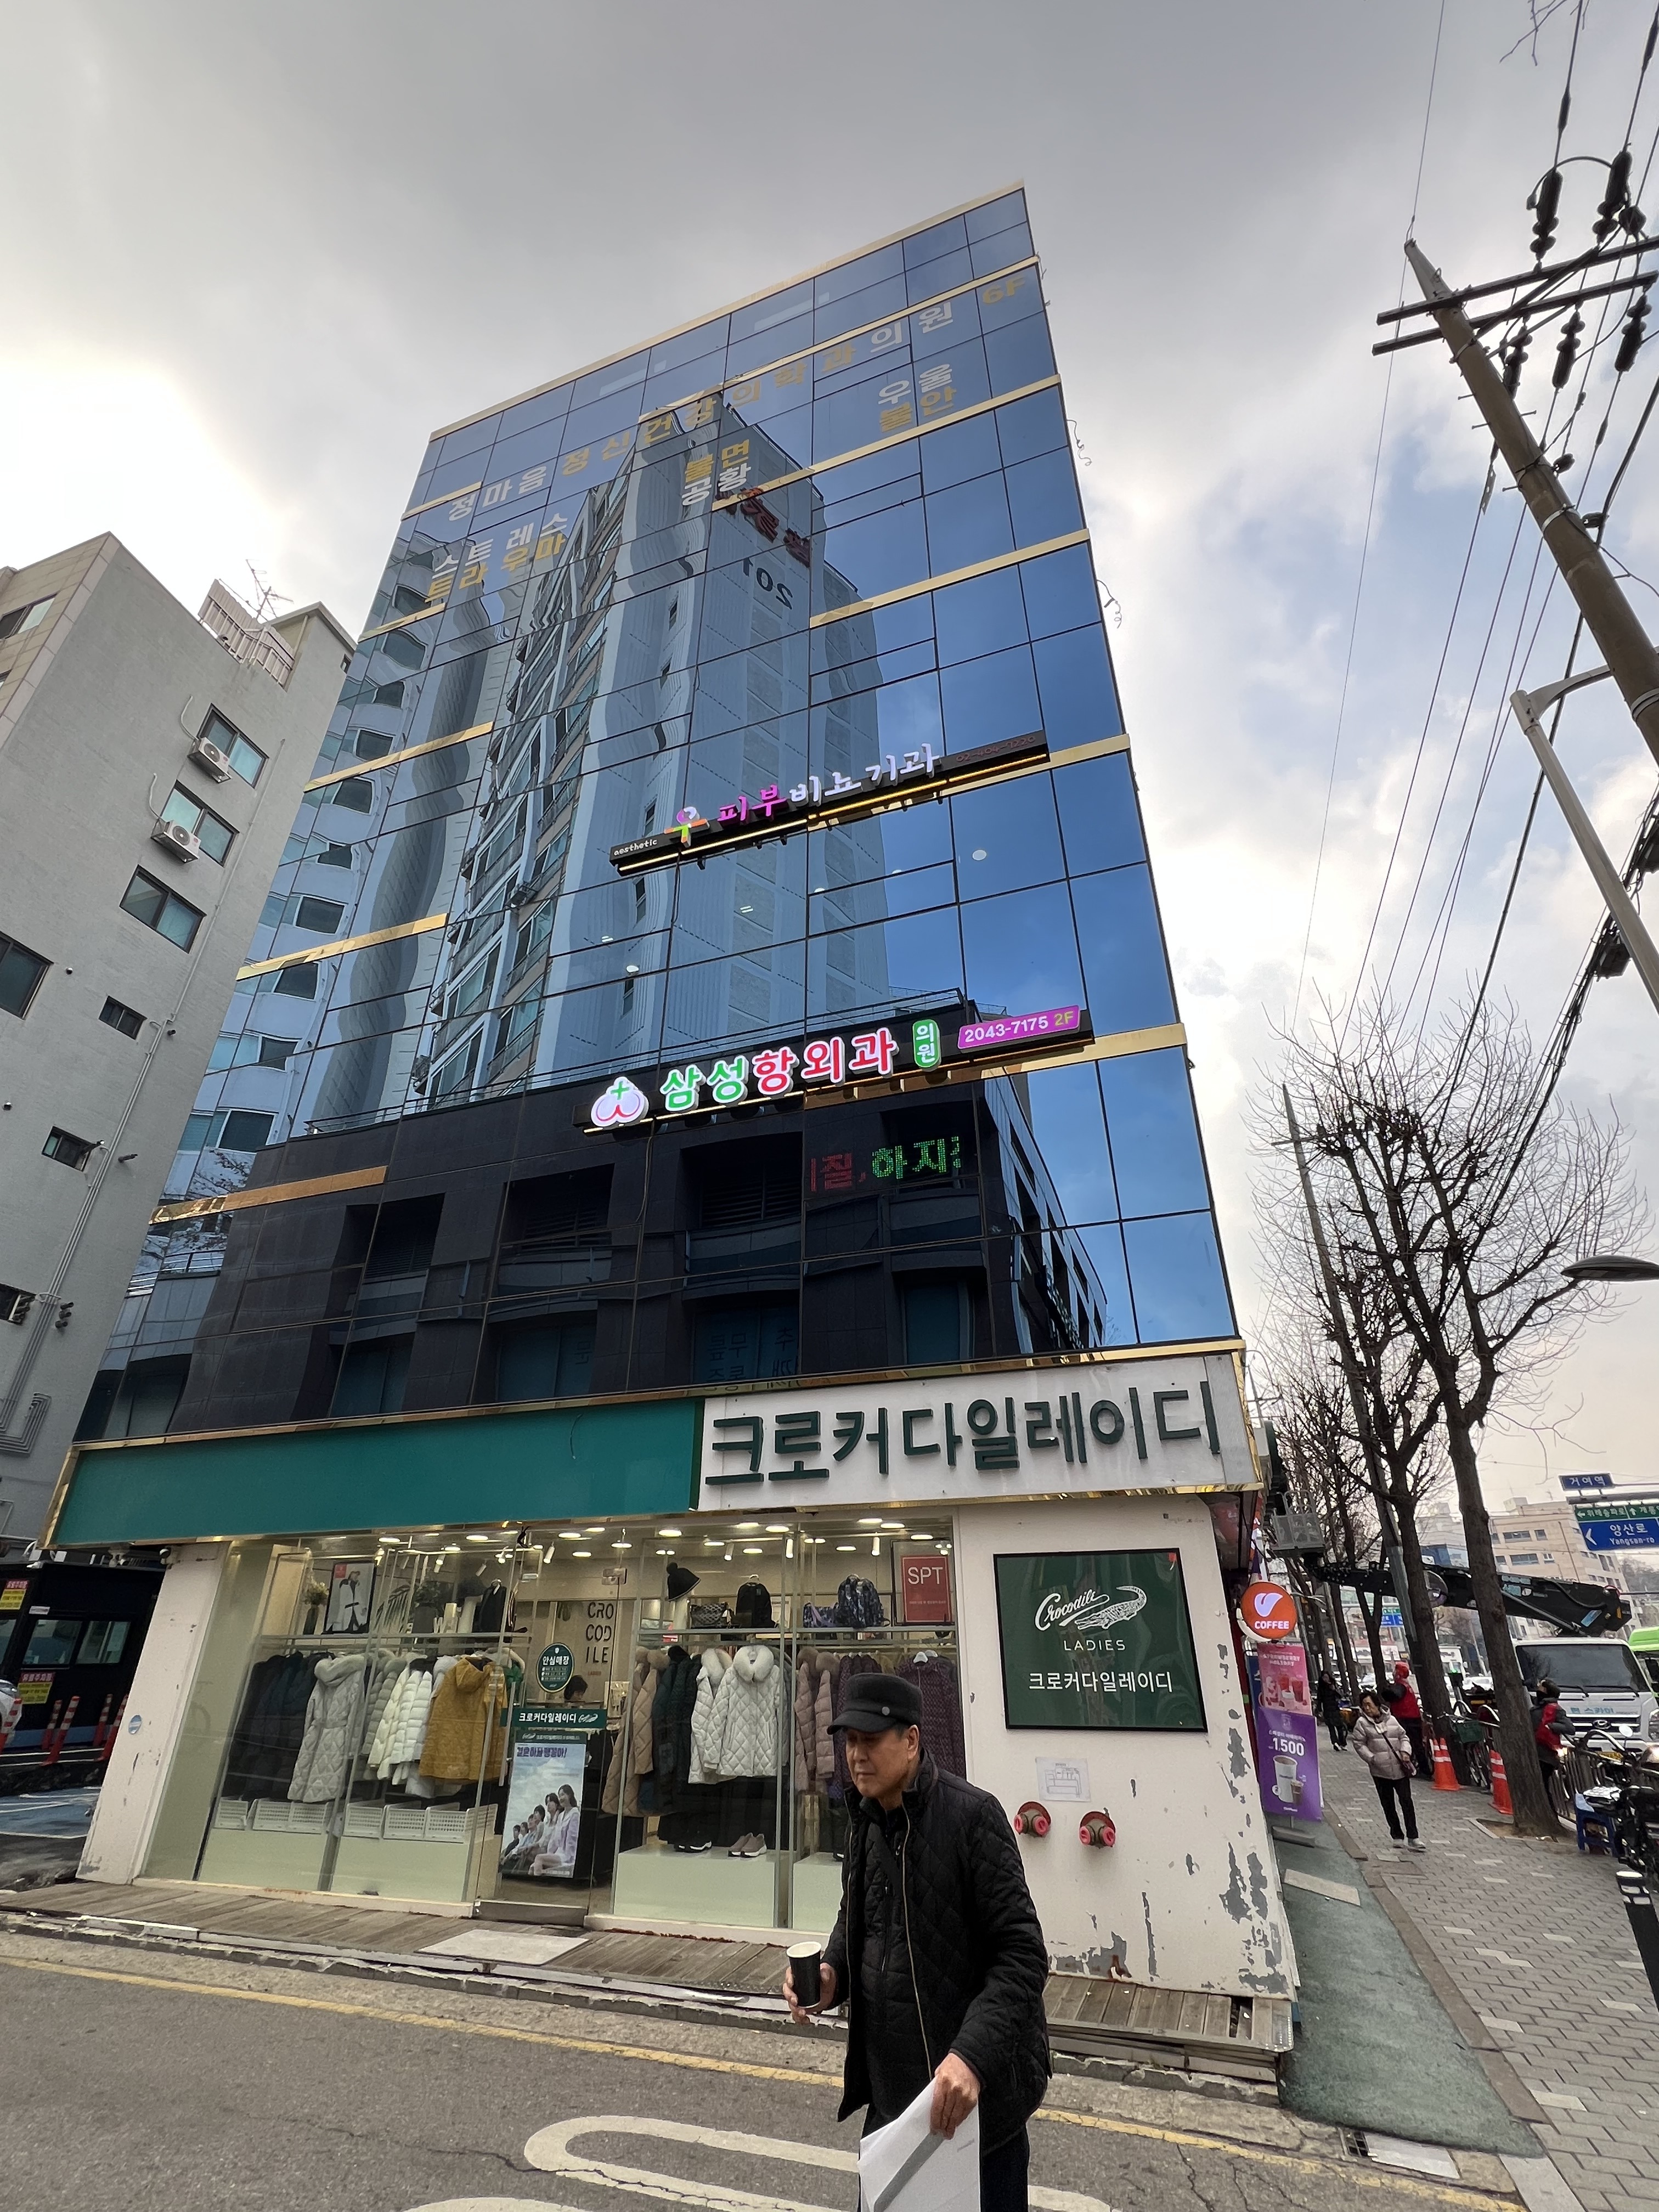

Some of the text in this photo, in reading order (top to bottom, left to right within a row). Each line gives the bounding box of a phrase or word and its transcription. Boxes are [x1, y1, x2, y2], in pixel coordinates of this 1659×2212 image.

[983, 276, 1026, 304] 6F
[878, 363, 953, 405] 우울
[879, 386, 957, 433] 불안
[685, 439, 749, 483] 불면
[682, 462, 752, 506] 공황
[432, 512, 568, 579] 스트레스
[424, 533, 567, 602] 트라우마
[614, 839, 657, 856] aesthetic
[956, 736, 1036, 762] 02-404-7220
[659, 1011, 1074, 1113] 삼성항외과 의원 2043-7175 2F
[704, 1381, 1222, 1485] 크로커다일레이디
[1570, 1476, 1606, 1486] 거여역
[1610, 1523, 1648, 1537] 양산로
[908, 1567, 943, 1584] SPT
[588, 1602, 614, 1619] CRO
[1035, 1589, 1103, 1631] Crocodile
[586, 1624, 612, 1641] COD
[1254, 1620, 1290, 1629] COFFEE
[585, 1646, 610, 1663] ILE
[1063, 1639, 1126, 1651] LADIES
[543, 1656, 569, 1666] 안심매장
[1029, 1671, 1173, 1692] 크로커다일레이디
[519, 1713, 577, 1723] 크로커다일레이디
